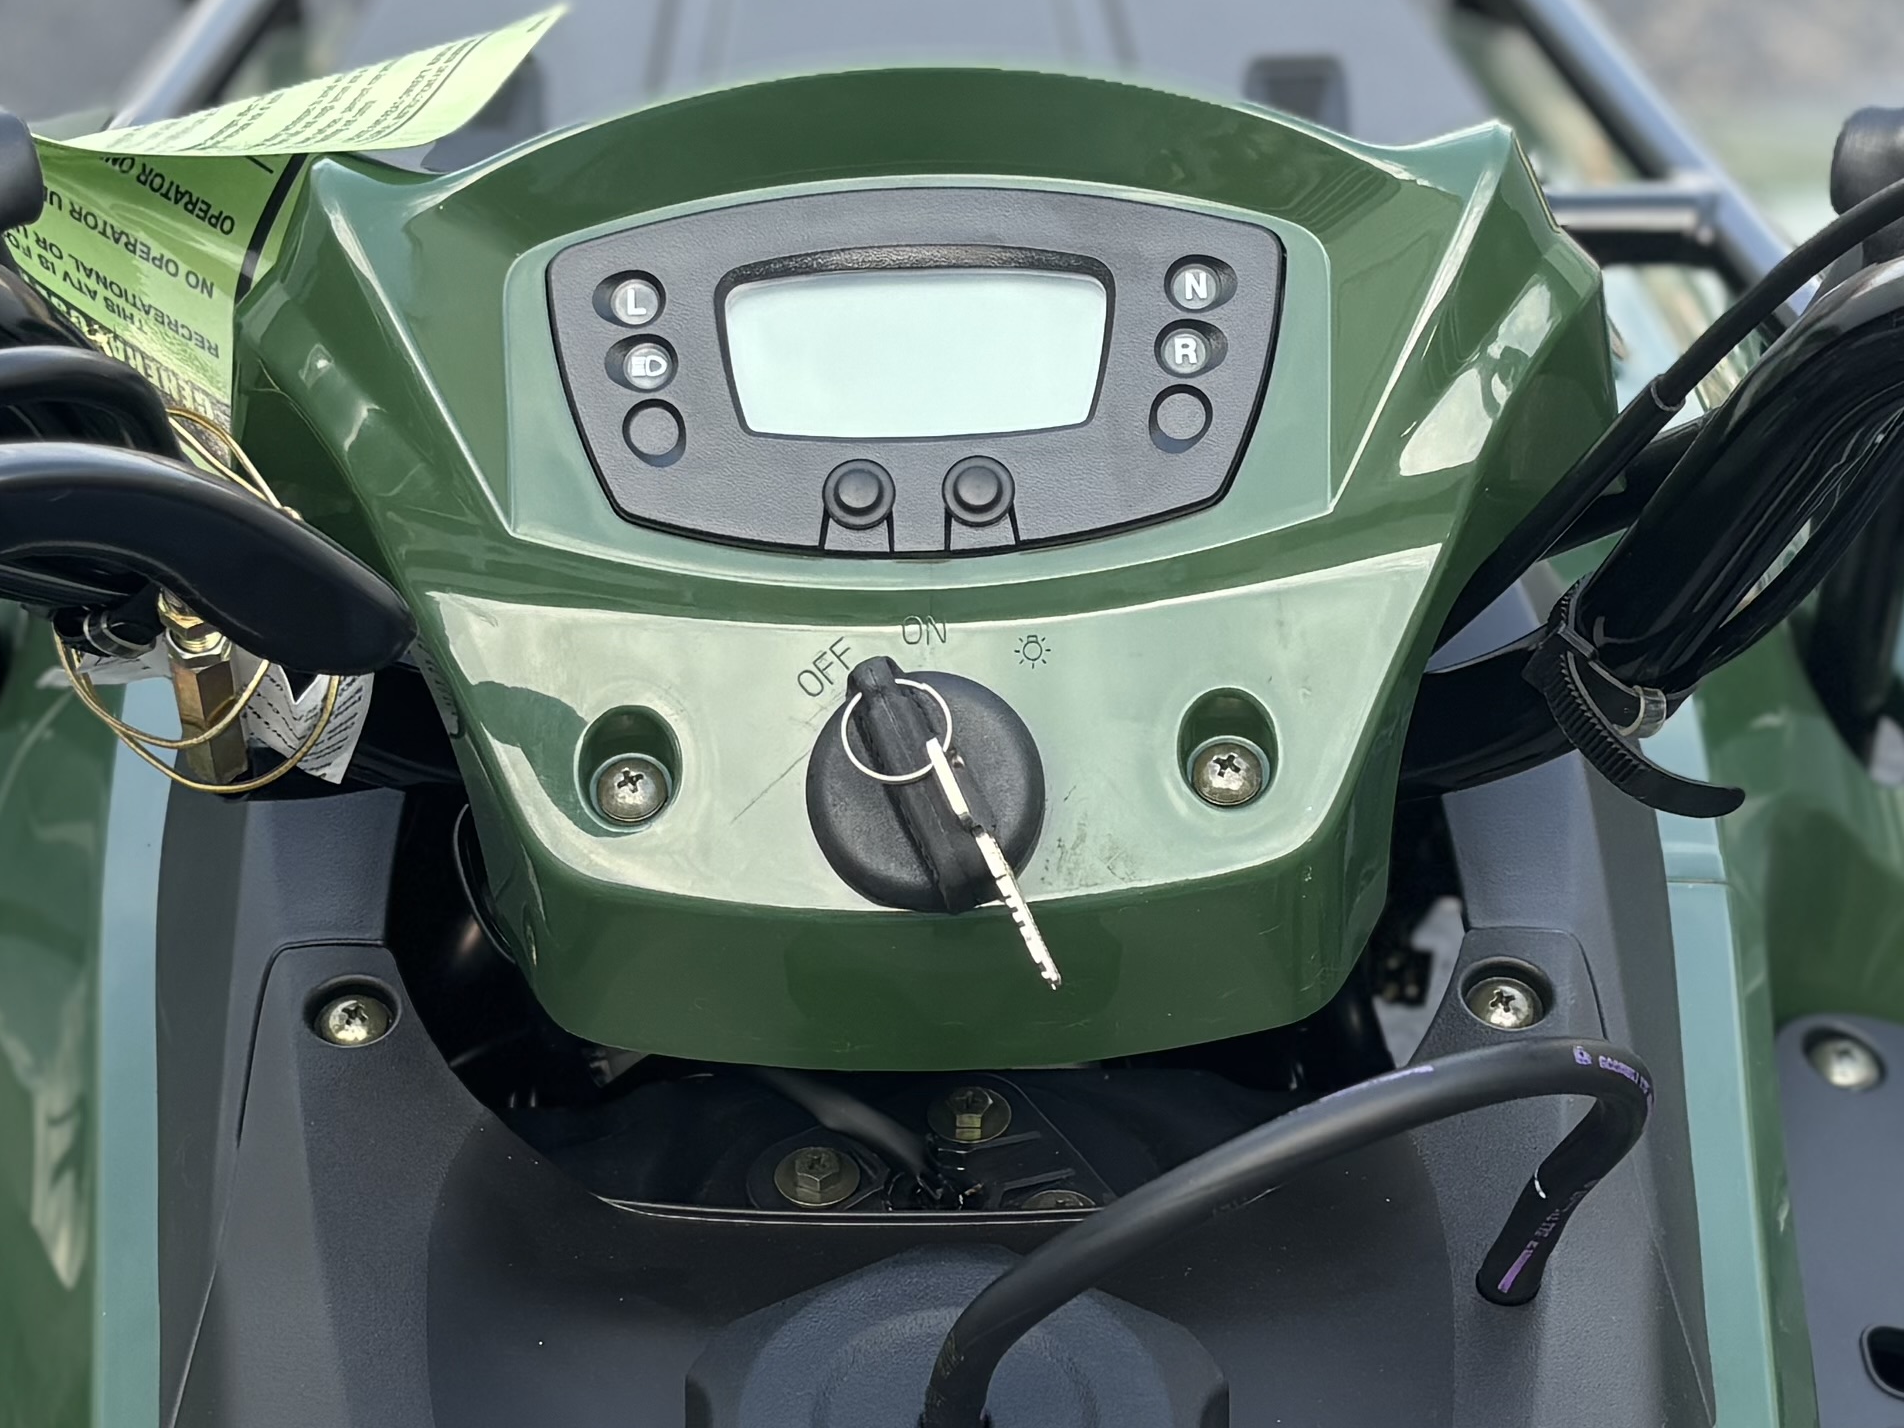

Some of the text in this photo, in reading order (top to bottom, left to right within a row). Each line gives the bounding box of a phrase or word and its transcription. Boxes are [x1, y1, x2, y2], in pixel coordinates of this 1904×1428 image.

[134, 162, 236, 236] OPERATOR
[2, 231, 31, 259] FO
[33, 231, 63, 260] OR
[69, 200, 215, 299] NO OPERATOR
[62, 270, 97, 301] ATV
[1184, 273, 1208, 299] N
[68, 253, 220, 359] RECREATIONAL
[104, 296, 147, 335] THIS
[626, 289, 646, 316] L
[1174, 339, 1198, 365] R
[901, 615, 948, 646] ON
[797, 635, 853, 699] OFF
